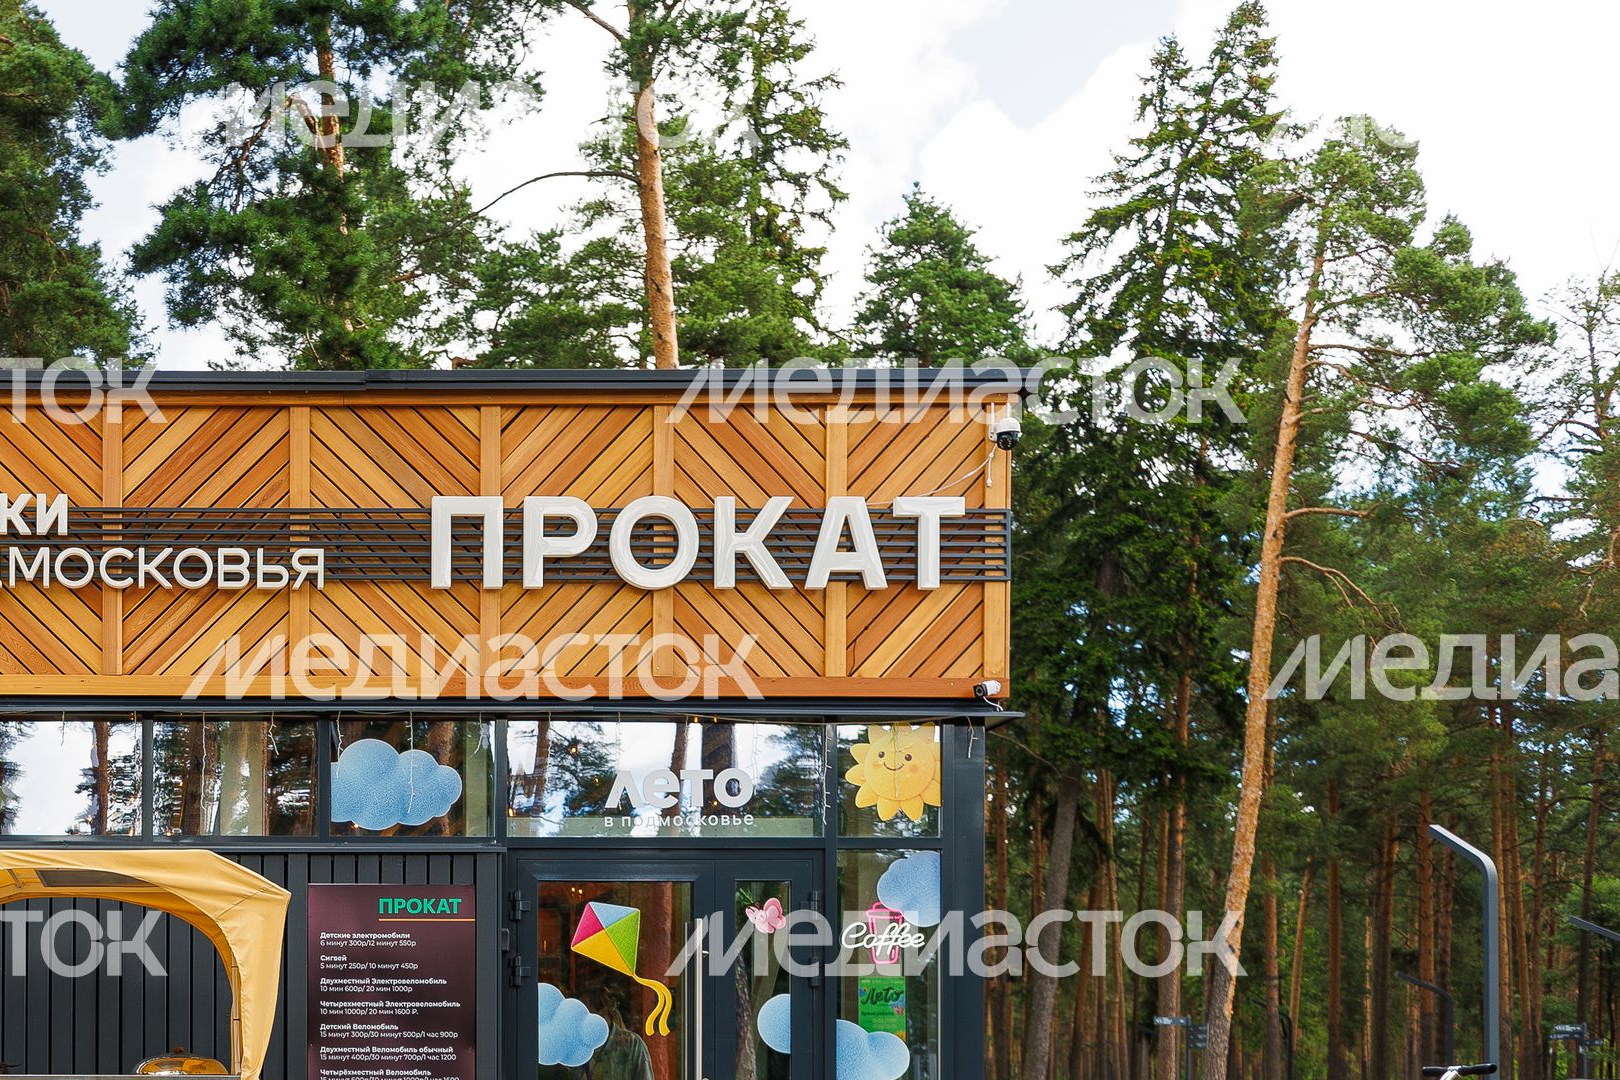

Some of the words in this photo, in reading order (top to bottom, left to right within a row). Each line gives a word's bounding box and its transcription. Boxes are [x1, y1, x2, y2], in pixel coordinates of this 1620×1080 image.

[431, 495, 966, 590] ПРОКАТ
[604, 816, 614, 828] в
[621, 813, 754, 829] подмосковье
[379, 898, 462, 914] ПРОКАТ
[320, 932, 351, 940] Детские
[352, 932, 410, 940] электромобили
[841, 922, 926, 956] Coffee
[348, 940, 375, 948] 300р/12
[399, 940, 416, 948] 550р
[320, 978, 370, 986] Двухместный
[371, 978, 447, 986] Электровеломобиль
[344, 985, 365, 993] 600р/
[392, 985, 413, 993] 1000р
[385, 1000, 460, 1009] Электровеломобиль
[344, 1008, 368, 1016] 1000р/
[320, 1023, 351, 1032] Детский
[351, 1031, 379, 1039] 300р/30
[403, 1031, 425, 1039] 500р/1
[439, 1031, 458, 1039] 900р
[320, 1046, 370, 1054] Двухместный
[351, 1054, 380, 1062] 400р/30
[403, 1054, 426, 1062] 700р/1
